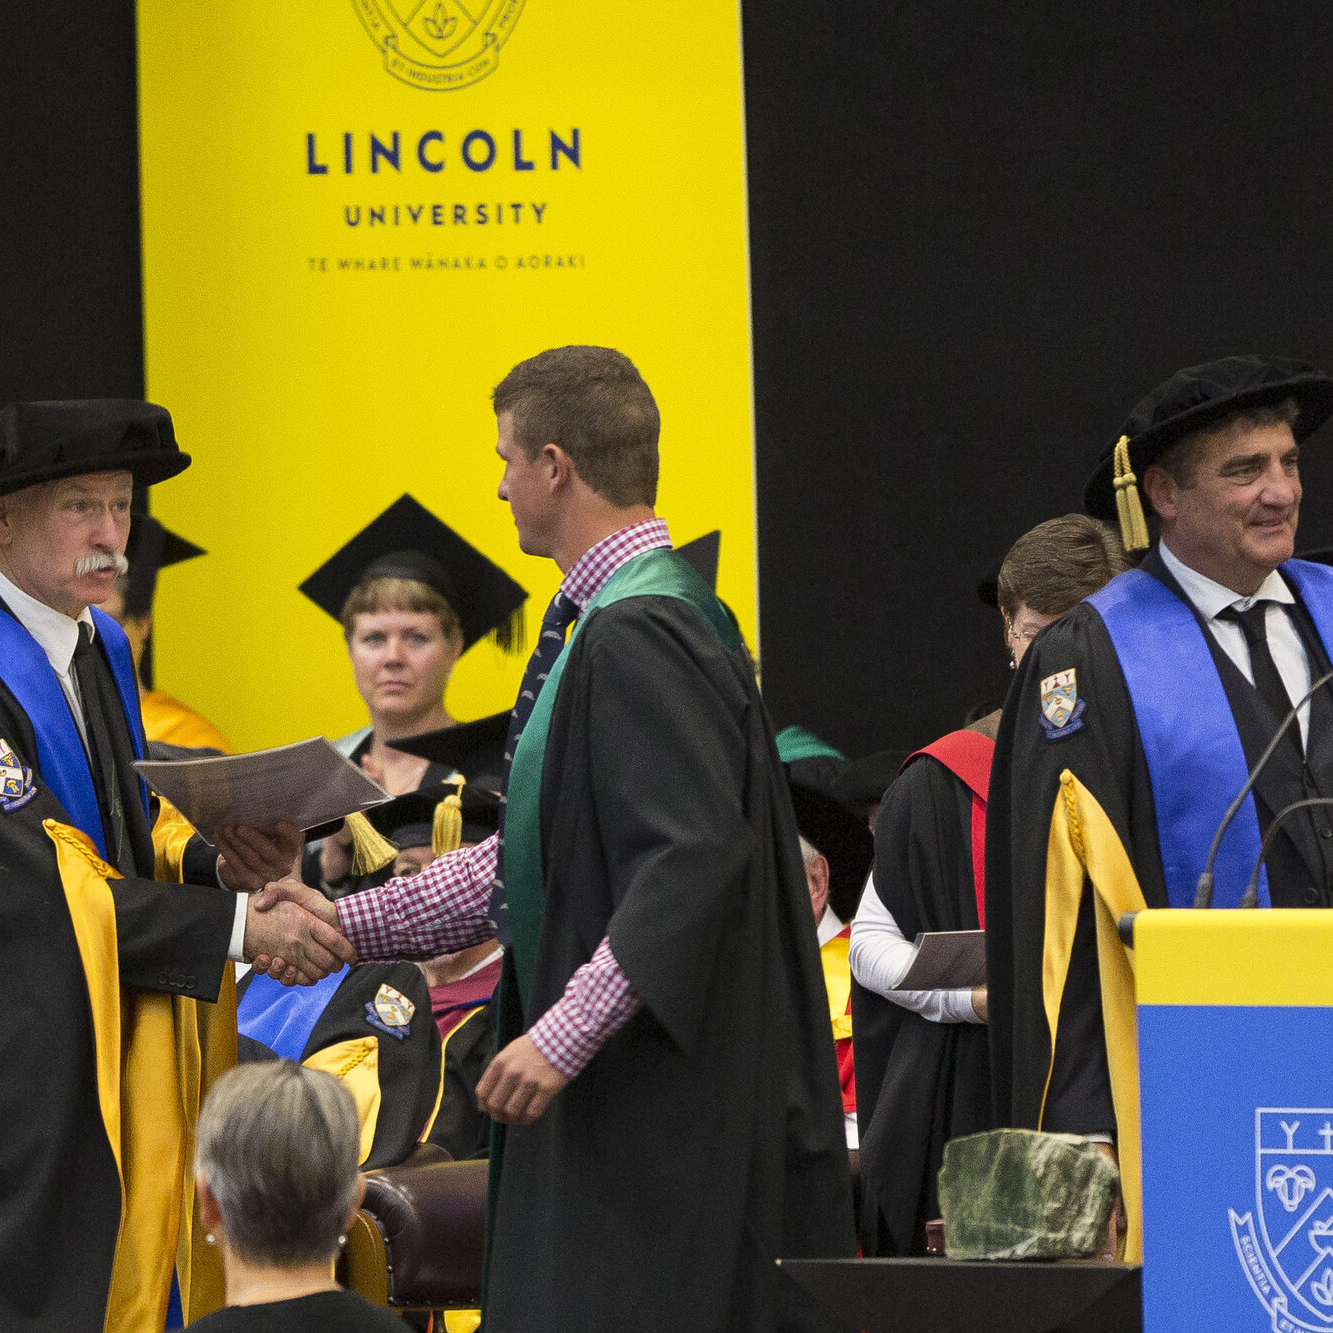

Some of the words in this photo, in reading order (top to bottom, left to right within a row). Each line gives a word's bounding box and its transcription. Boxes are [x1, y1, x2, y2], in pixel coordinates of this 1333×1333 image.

[306, 128, 582, 175] LINCOLN
[344, 203, 547, 227] UNIVERSITY
[307, 257, 327, 272] TE
[338, 256, 401, 271] WHARE
[410, 252, 487, 270] WĀNAKA
[495, 255, 508, 269] O
[517, 255, 585, 269] AORAKI
